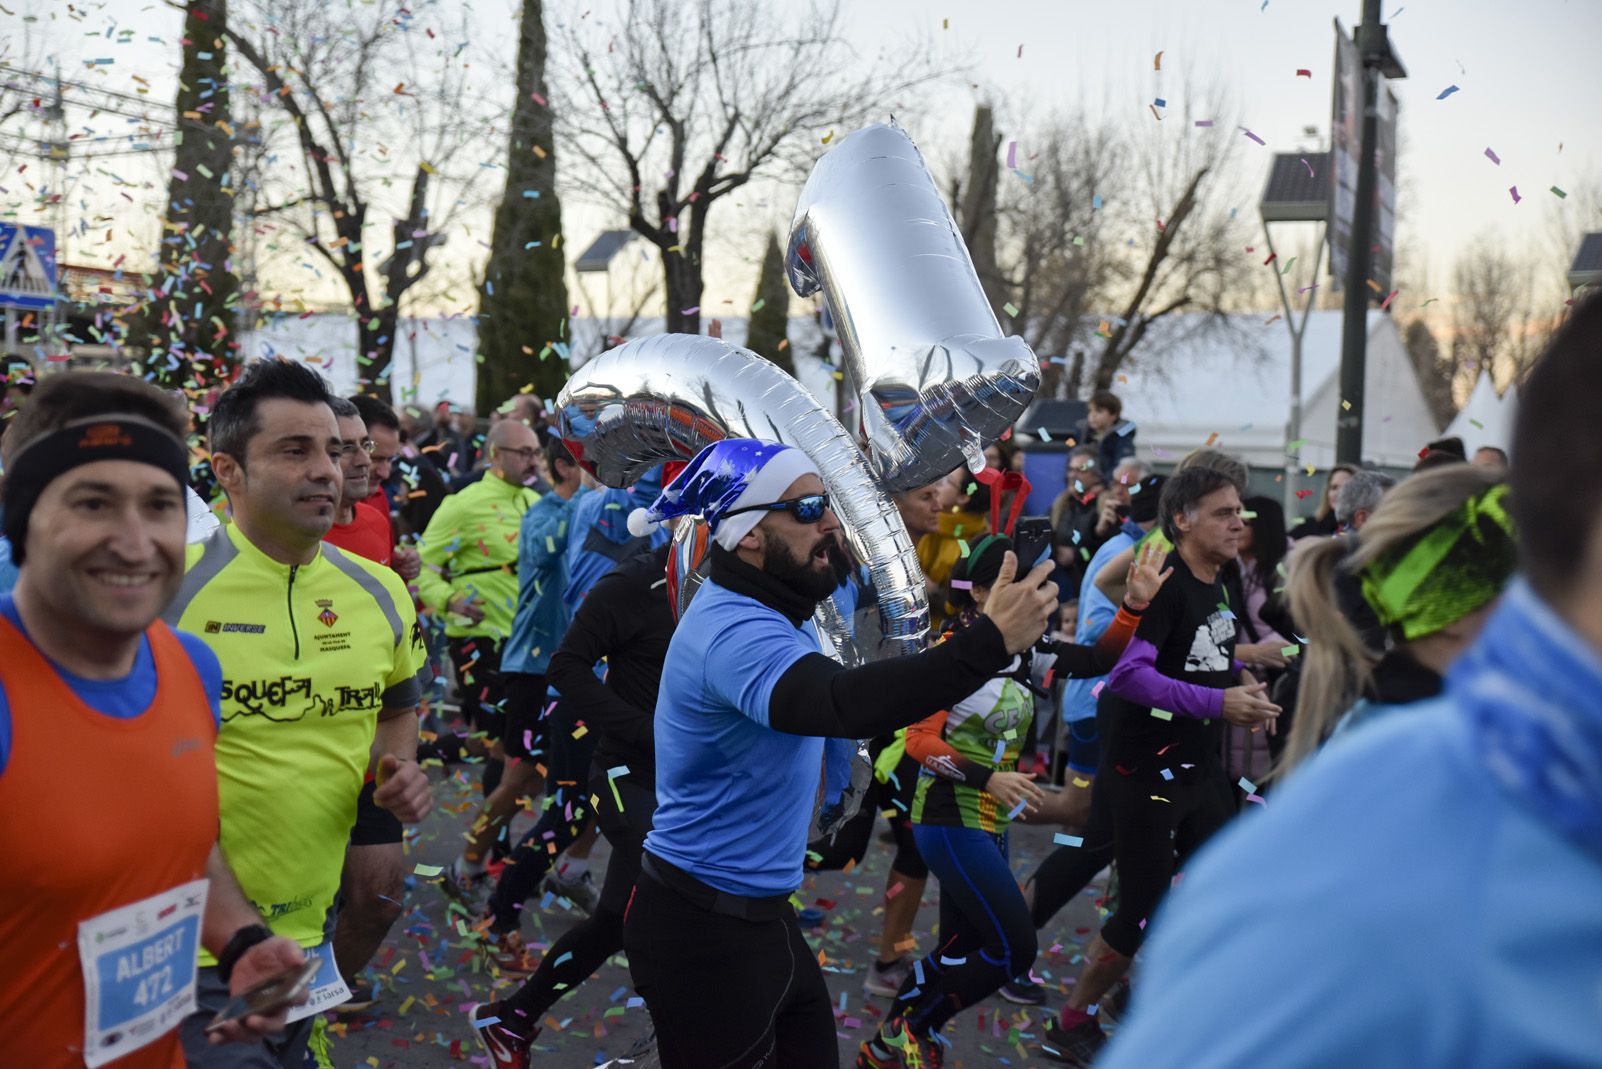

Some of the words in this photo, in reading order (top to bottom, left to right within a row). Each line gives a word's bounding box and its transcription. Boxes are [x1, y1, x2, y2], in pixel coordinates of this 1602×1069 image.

[221, 676, 311, 713] SQUEFA
[116, 927, 186, 983] ALBERT
[133, 965, 173, 1006] 472
